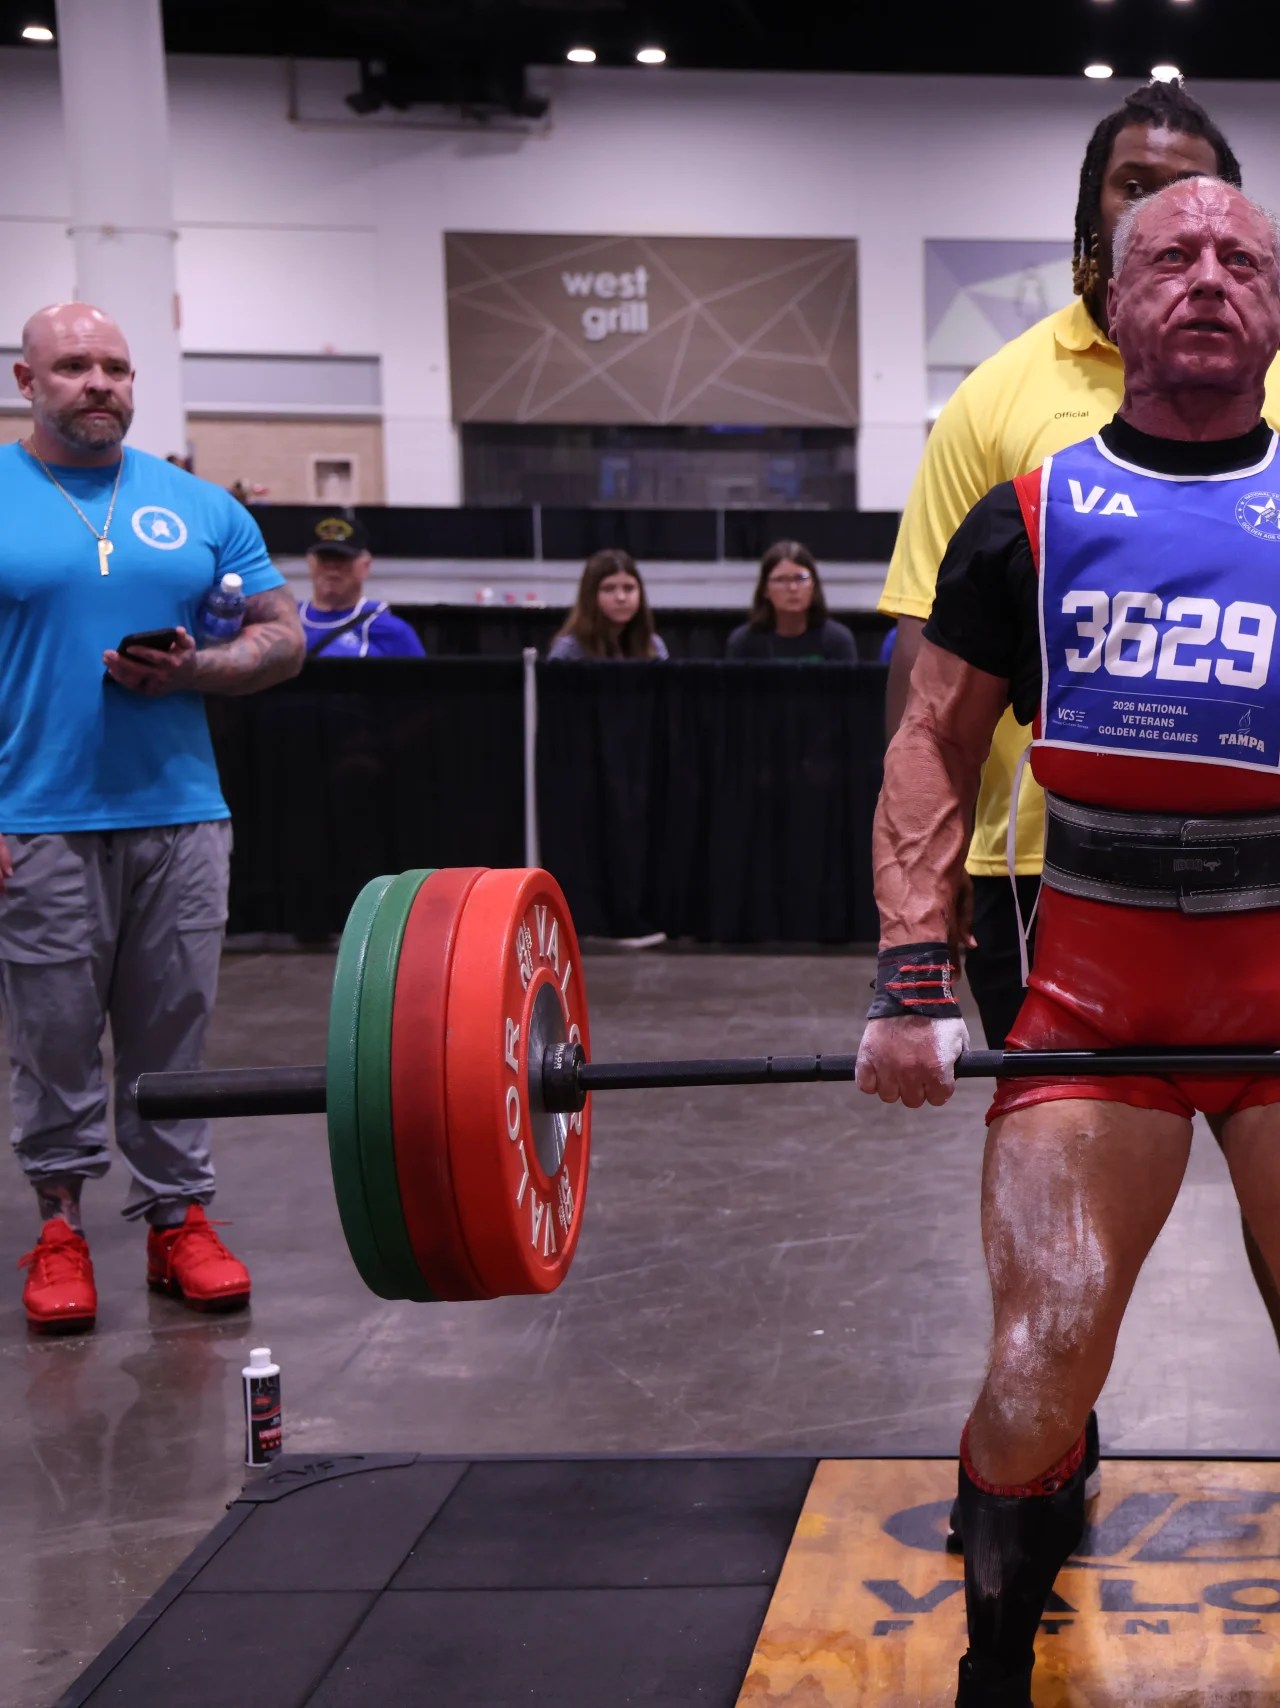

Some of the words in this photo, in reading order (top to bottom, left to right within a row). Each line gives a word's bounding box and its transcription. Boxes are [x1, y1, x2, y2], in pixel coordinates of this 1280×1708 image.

[562, 266, 649, 298] west
[582, 301, 649, 341] grill
[1054, 411, 1089, 419] Official
[1067, 479, 1138, 517] VA
[1242, 521, 1262, 537] GOLDEN
[1061, 590, 1277, 690] 3629
[1058, 707, 1075, 721] VCS
[1113, 701, 1135, 711] 2026
[1138, 703, 1189, 716] NATIONAL
[1122, 715, 1175, 727] VETERANS
[1098, 726, 1136, 738] GOLDEN
[1139, 730, 1159, 740] AGE
[1162, 732, 1199, 743] GAMES
[1218, 733, 1265, 752] TAMPA
[505, 1017, 558, 1257] VALOR
